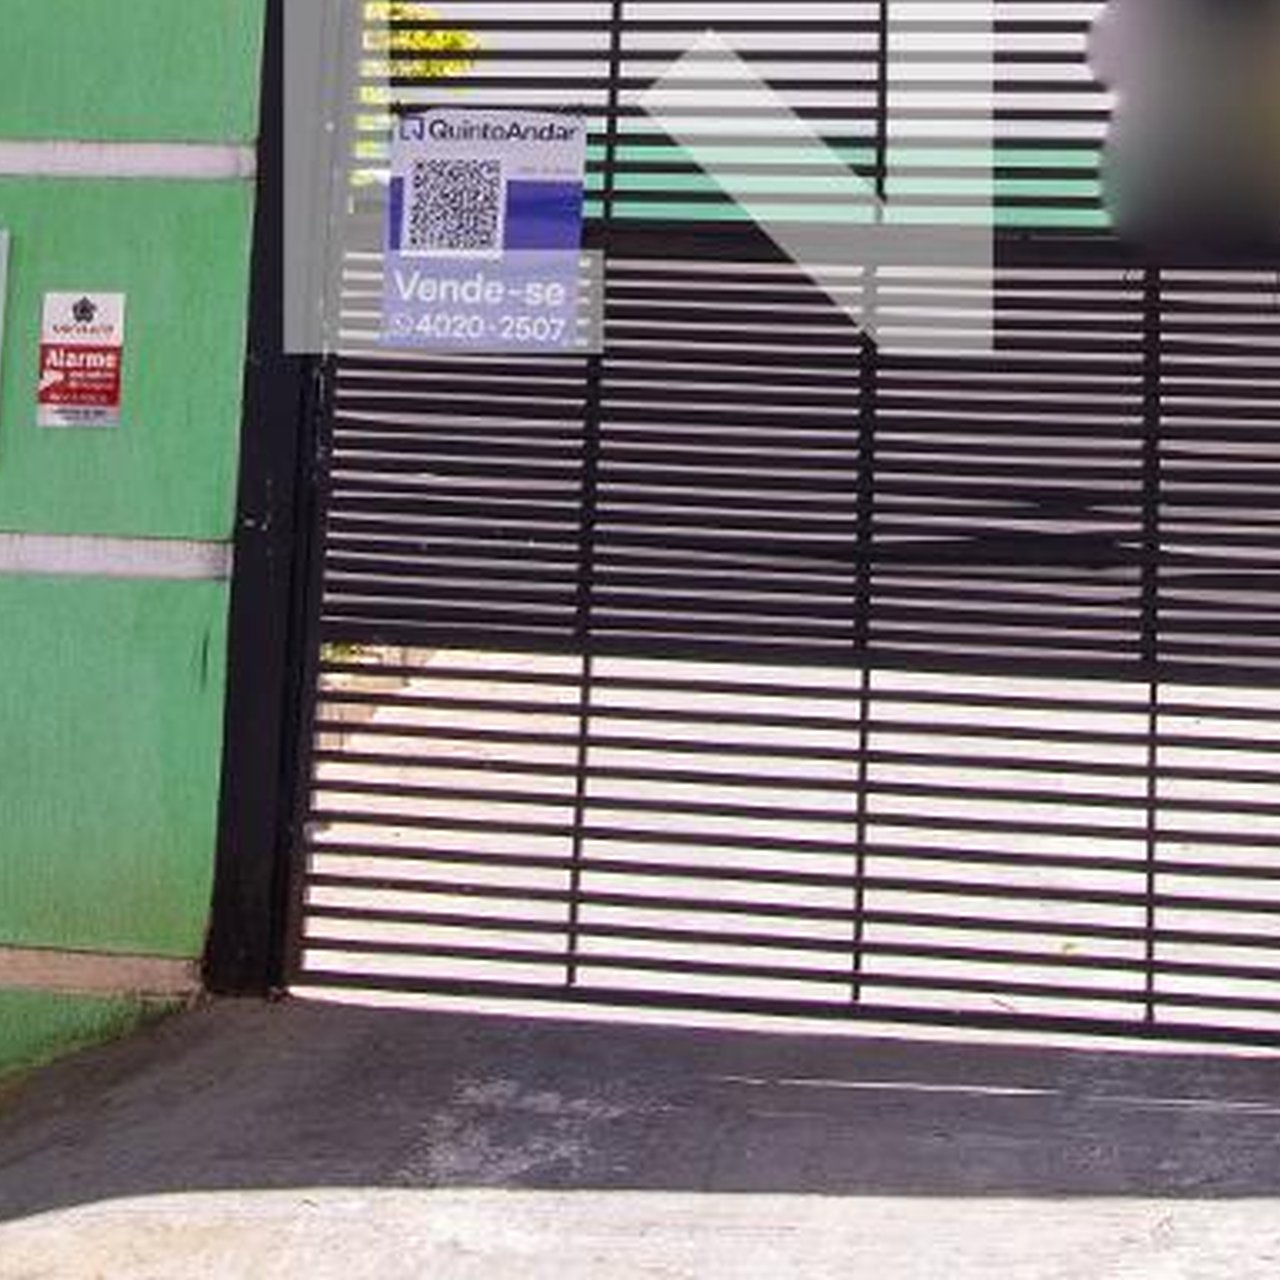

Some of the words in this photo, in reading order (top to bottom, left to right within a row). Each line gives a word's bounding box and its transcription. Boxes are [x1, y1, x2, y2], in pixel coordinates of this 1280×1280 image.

[428, 119, 578, 141] QuintoAndar
[394, 270, 566, 307] Vende-se
[45, 347, 117, 369] Alarme
